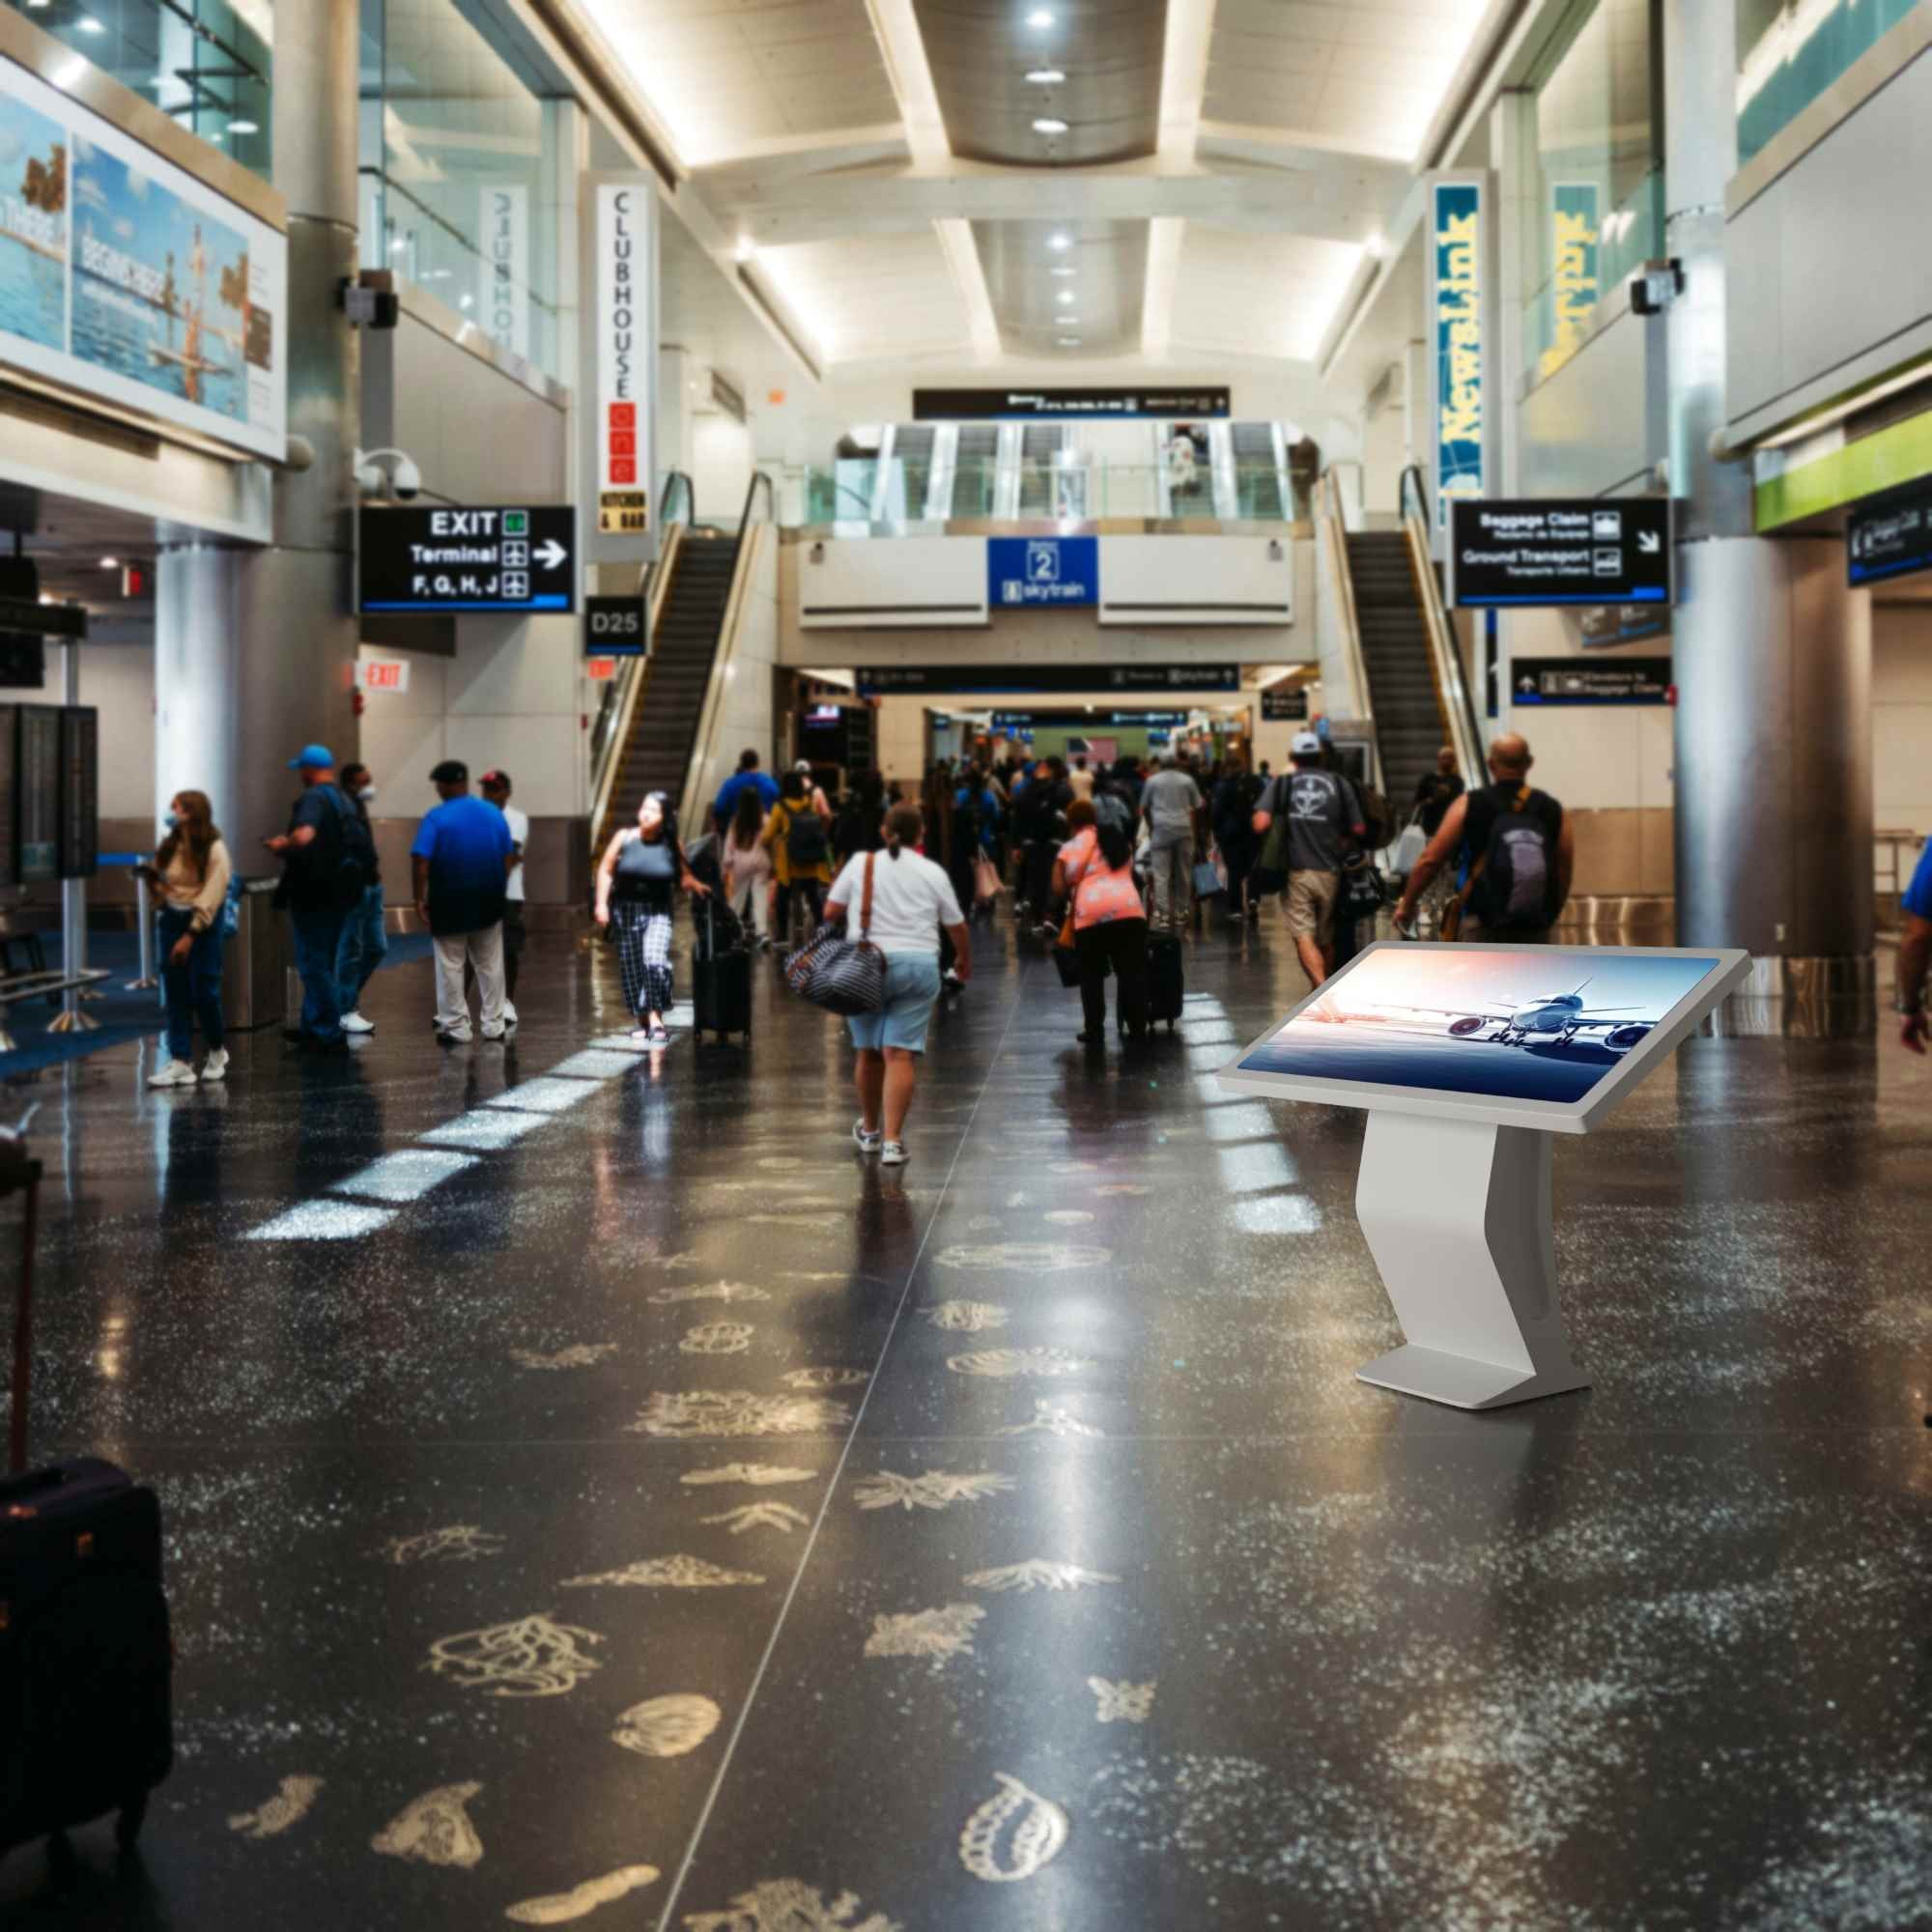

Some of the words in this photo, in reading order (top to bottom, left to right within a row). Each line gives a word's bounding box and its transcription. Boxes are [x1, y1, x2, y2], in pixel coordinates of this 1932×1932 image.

[612, 191, 633, 399] CLUBHOUSE
[1437, 212, 1480, 444] NewsLink
[431, 511, 497, 535] EXIT
[621, 512, 645, 528] BAR
[1480, 513, 1545, 529] Baggage
[1548, 512, 1590, 526] Claim
[411, 544, 497, 563] Terminal
[1462, 549, 1518, 564] Ground
[1520, 548, 1590, 565] Transport
[1036, 553, 1052, 578] 2
[412, 576, 430, 596] F,
[434, 576, 456, 596] G,
[461, 576, 482, 596] H,
[486, 576, 497, 594] J
[1024, 580, 1086, 600] skytrain
[591, 612, 639, 633] D25
[366, 664, 401, 687] EXIT
